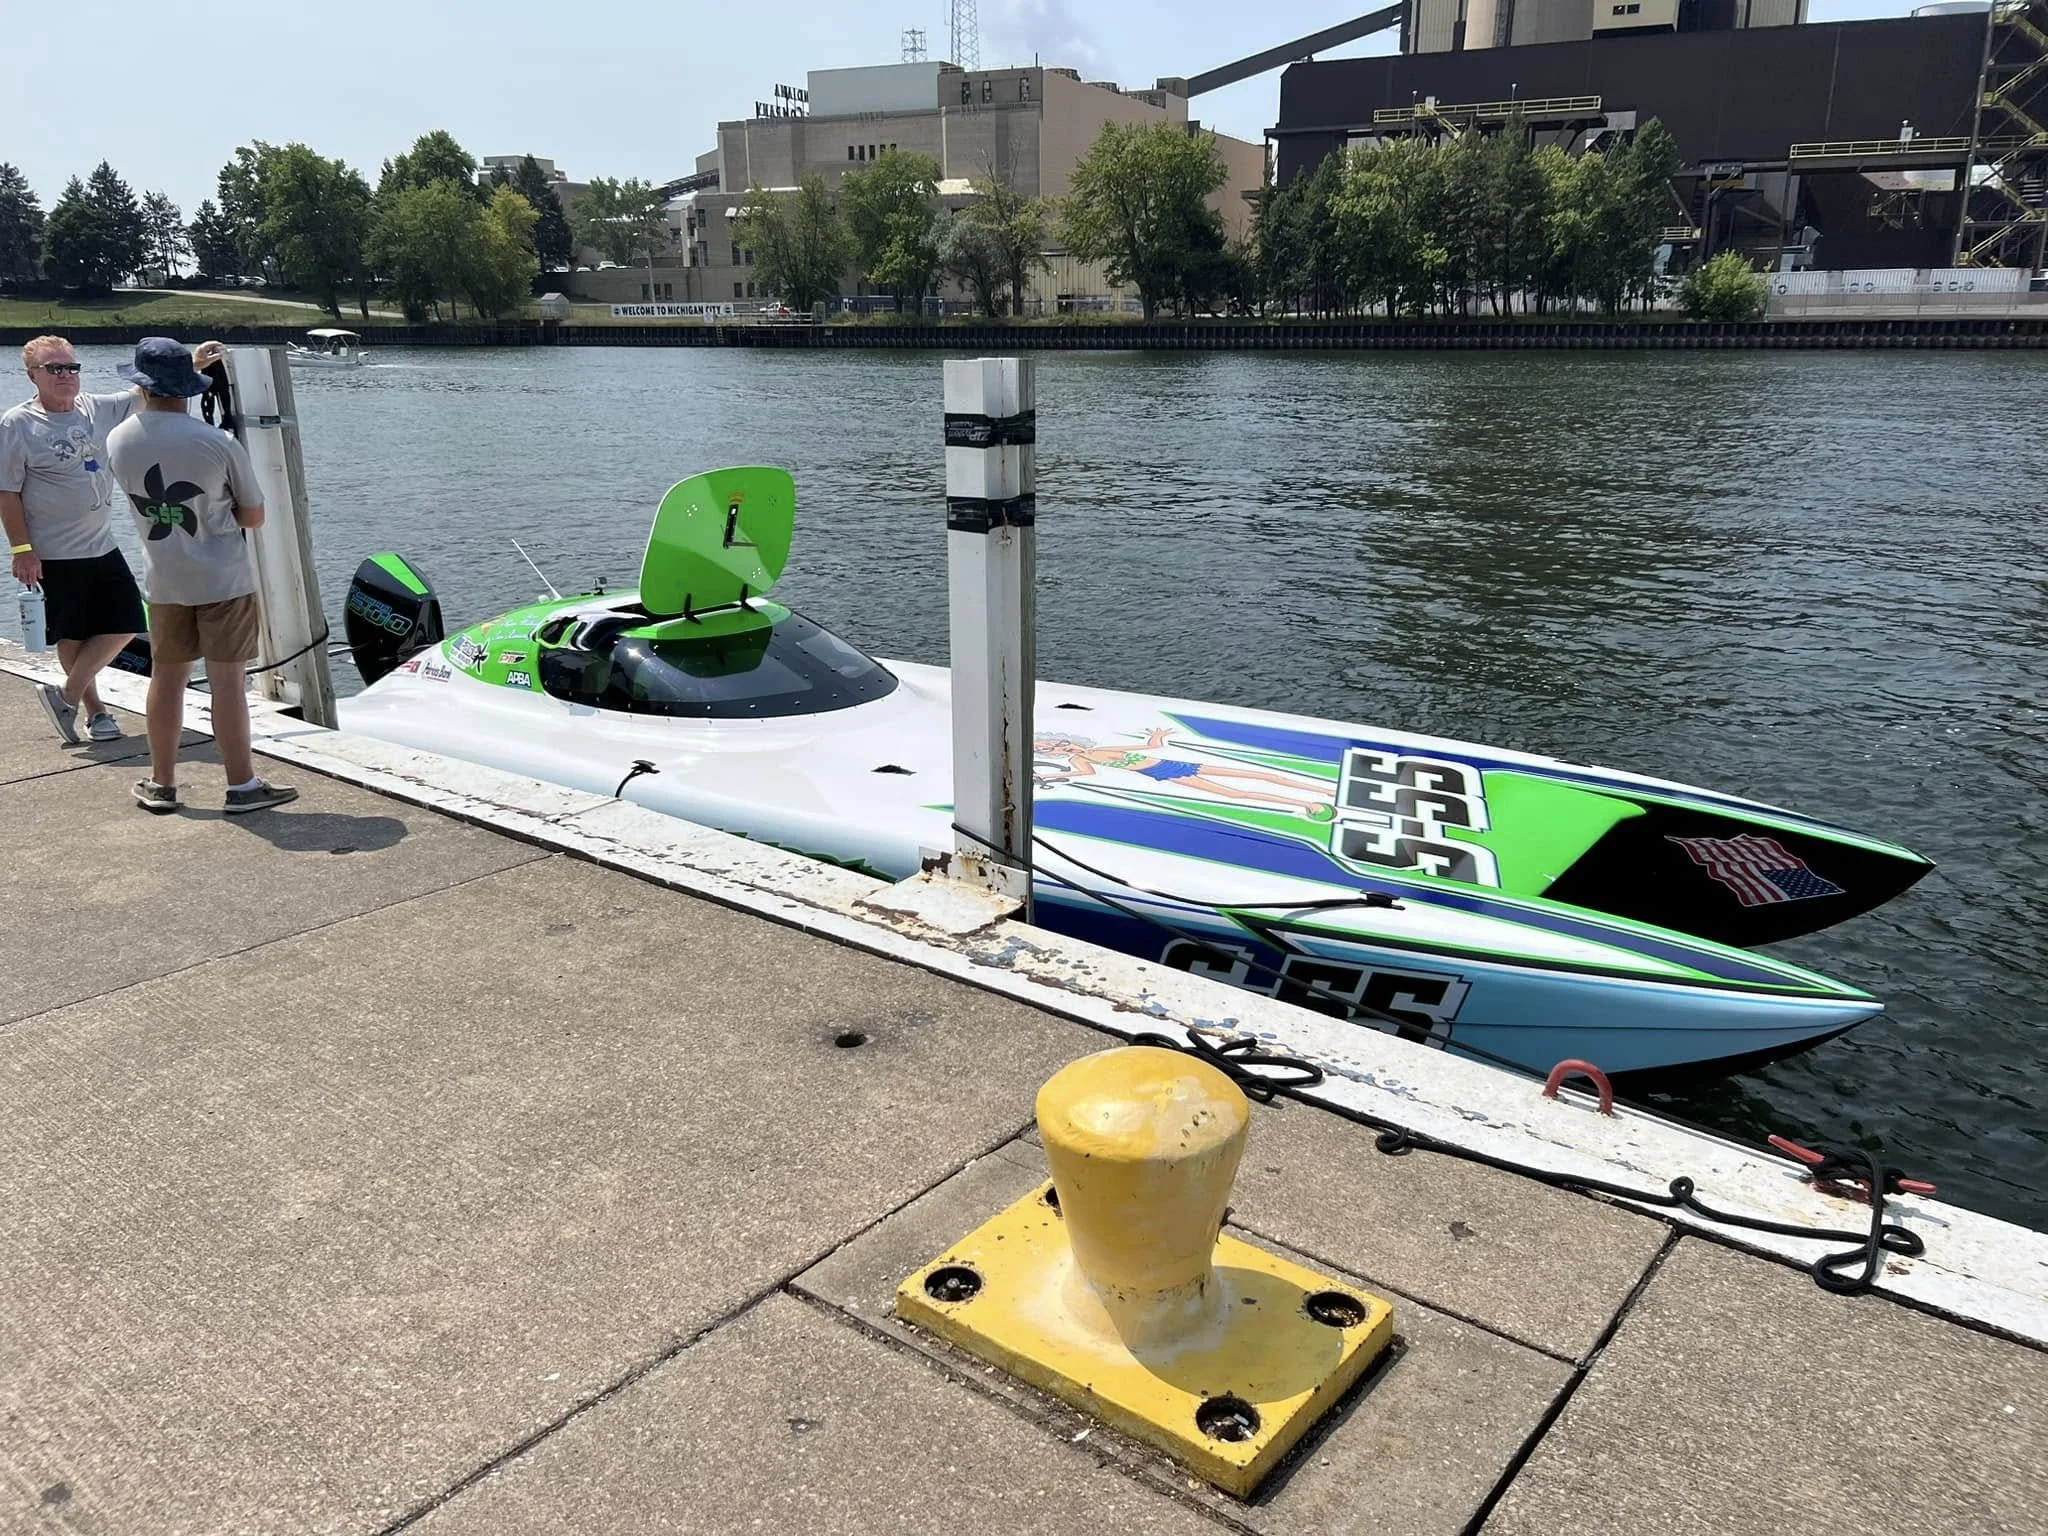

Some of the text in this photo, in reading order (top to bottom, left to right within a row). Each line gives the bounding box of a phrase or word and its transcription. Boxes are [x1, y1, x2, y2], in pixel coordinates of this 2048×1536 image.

[621, 305, 655, 316] WELCOME
[656, 305, 666, 315] TO
[667, 305, 704, 315] MICHIGAN
